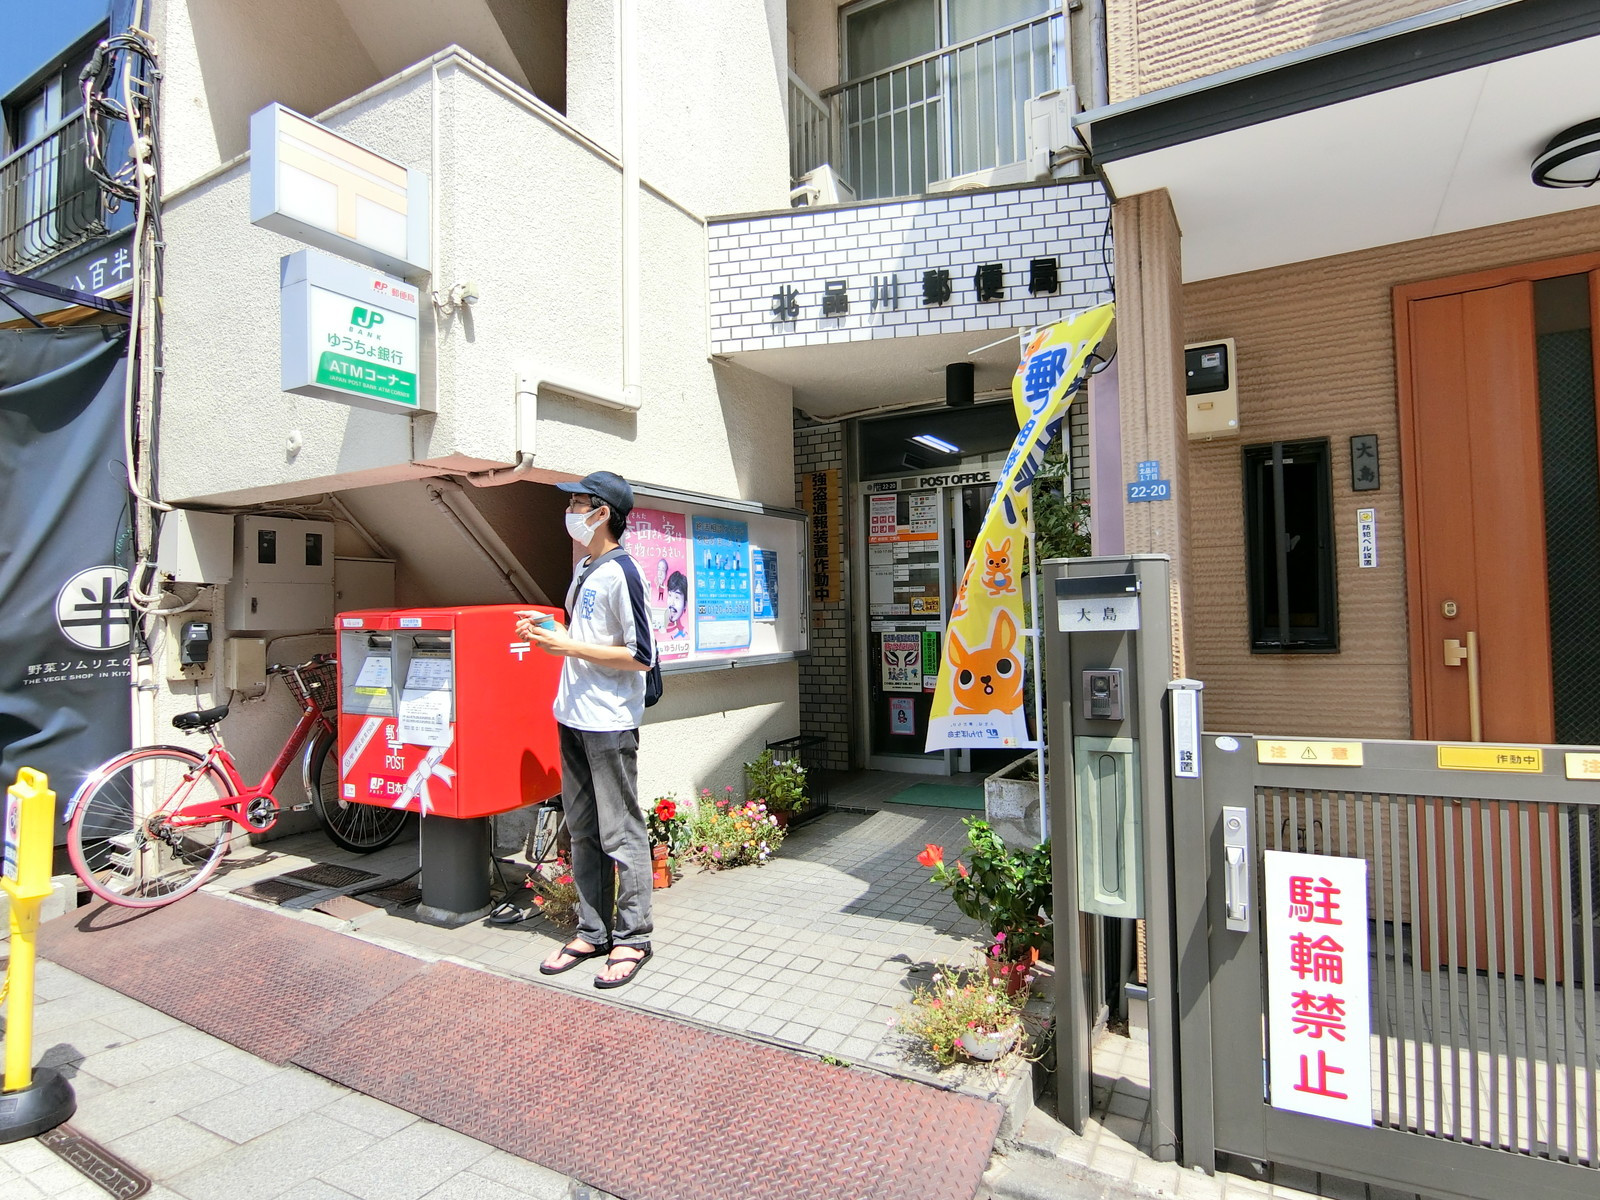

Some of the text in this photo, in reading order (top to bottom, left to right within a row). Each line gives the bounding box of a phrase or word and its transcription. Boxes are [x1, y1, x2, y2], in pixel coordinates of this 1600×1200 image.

[773, 258, 1058, 321] 北品川郵便局
[351, 306, 384, 329] JP
[348, 326, 382, 340] BANK
[328, 332, 404, 365] ゆうちょ銀行
[329, 360, 411, 386] ATMコーナー
[348, 379, 362, 387] POST
[363, 383, 377, 391] BANK
[378, 386, 390, 394] ATM
[1356, 442, 1375, 483] 大島
[920, 471, 991, 488] POST OFFICE
[1131, 485, 1166, 498] 22-20
[812, 472, 829, 602] 強盗通報装置作動中
[1361, 525, 1372, 566] 防犯ベル設置
[1077, 607, 1117, 622] 大島
[385, 755, 405, 770] POST
[1496, 754, 1536, 765] 作動中
[1288, 876, 1348, 1100] 駐輪禁止
